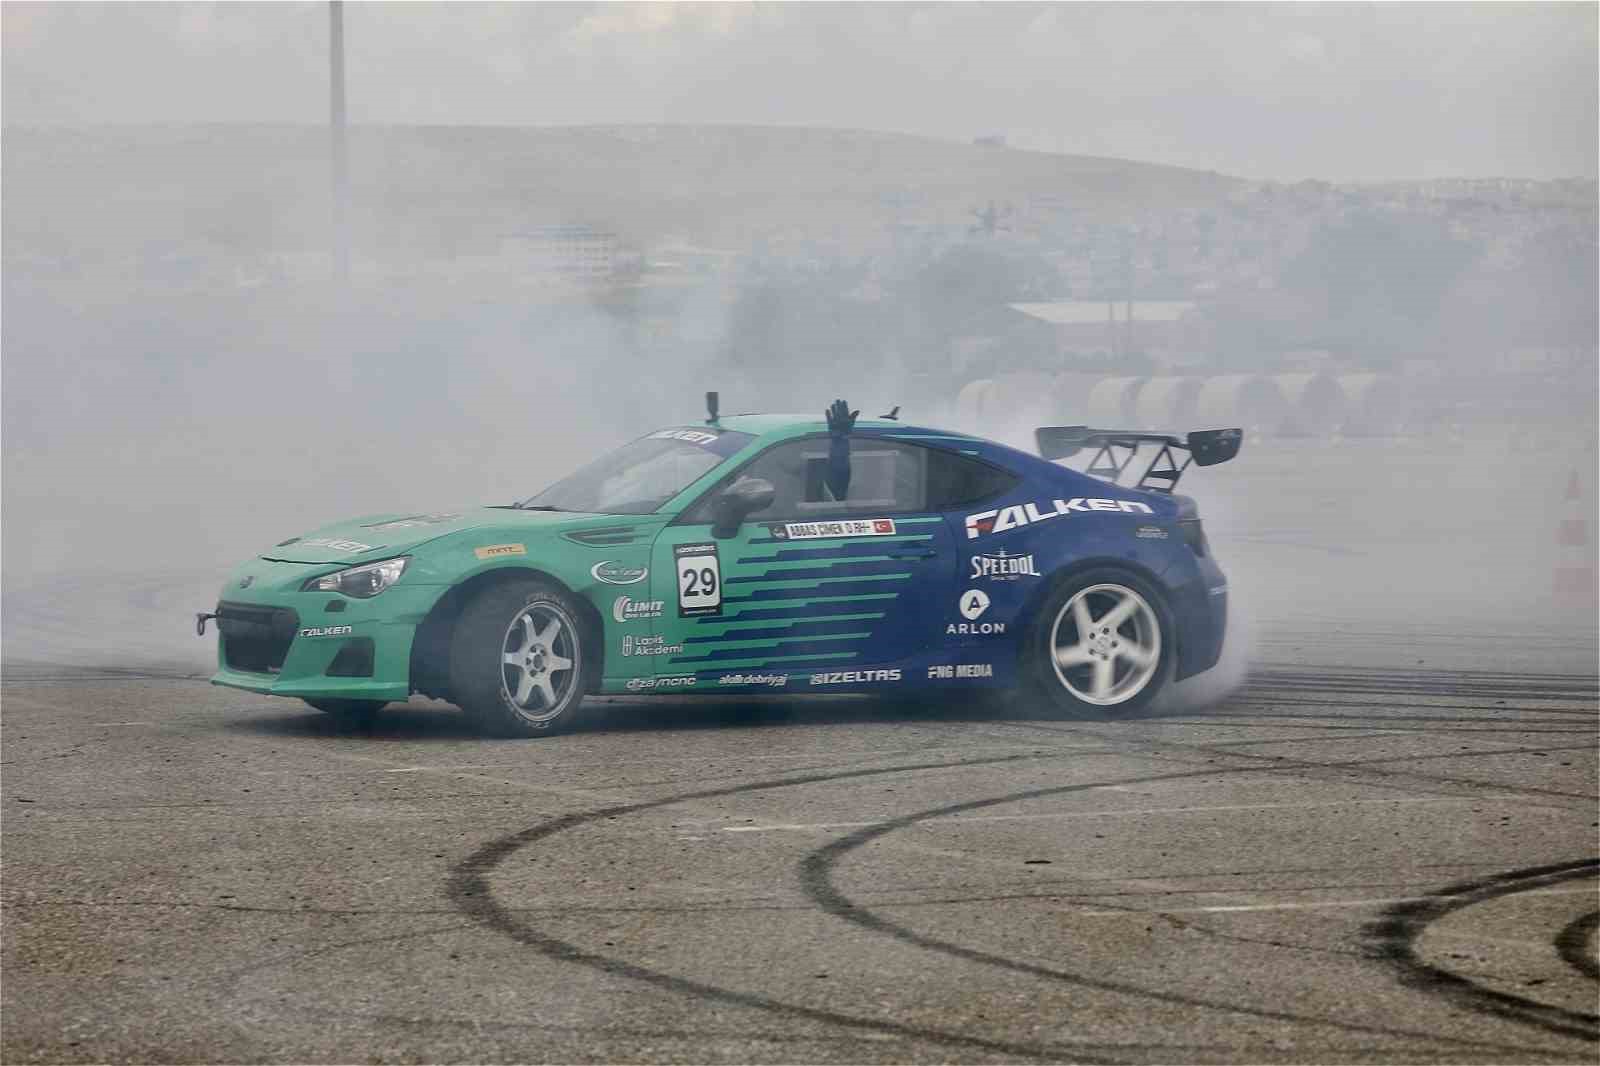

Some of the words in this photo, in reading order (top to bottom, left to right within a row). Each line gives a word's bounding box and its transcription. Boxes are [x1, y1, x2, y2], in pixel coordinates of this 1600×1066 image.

[965, 498, 1154, 539] FALKEN
[970, 554, 1041, 579] SPEEDOL
[682, 567, 717, 597] 29
[625, 601, 664, 612] LIMIT
[946, 623, 1006, 634] ARLON
[956, 664, 992, 677] MEDIA
